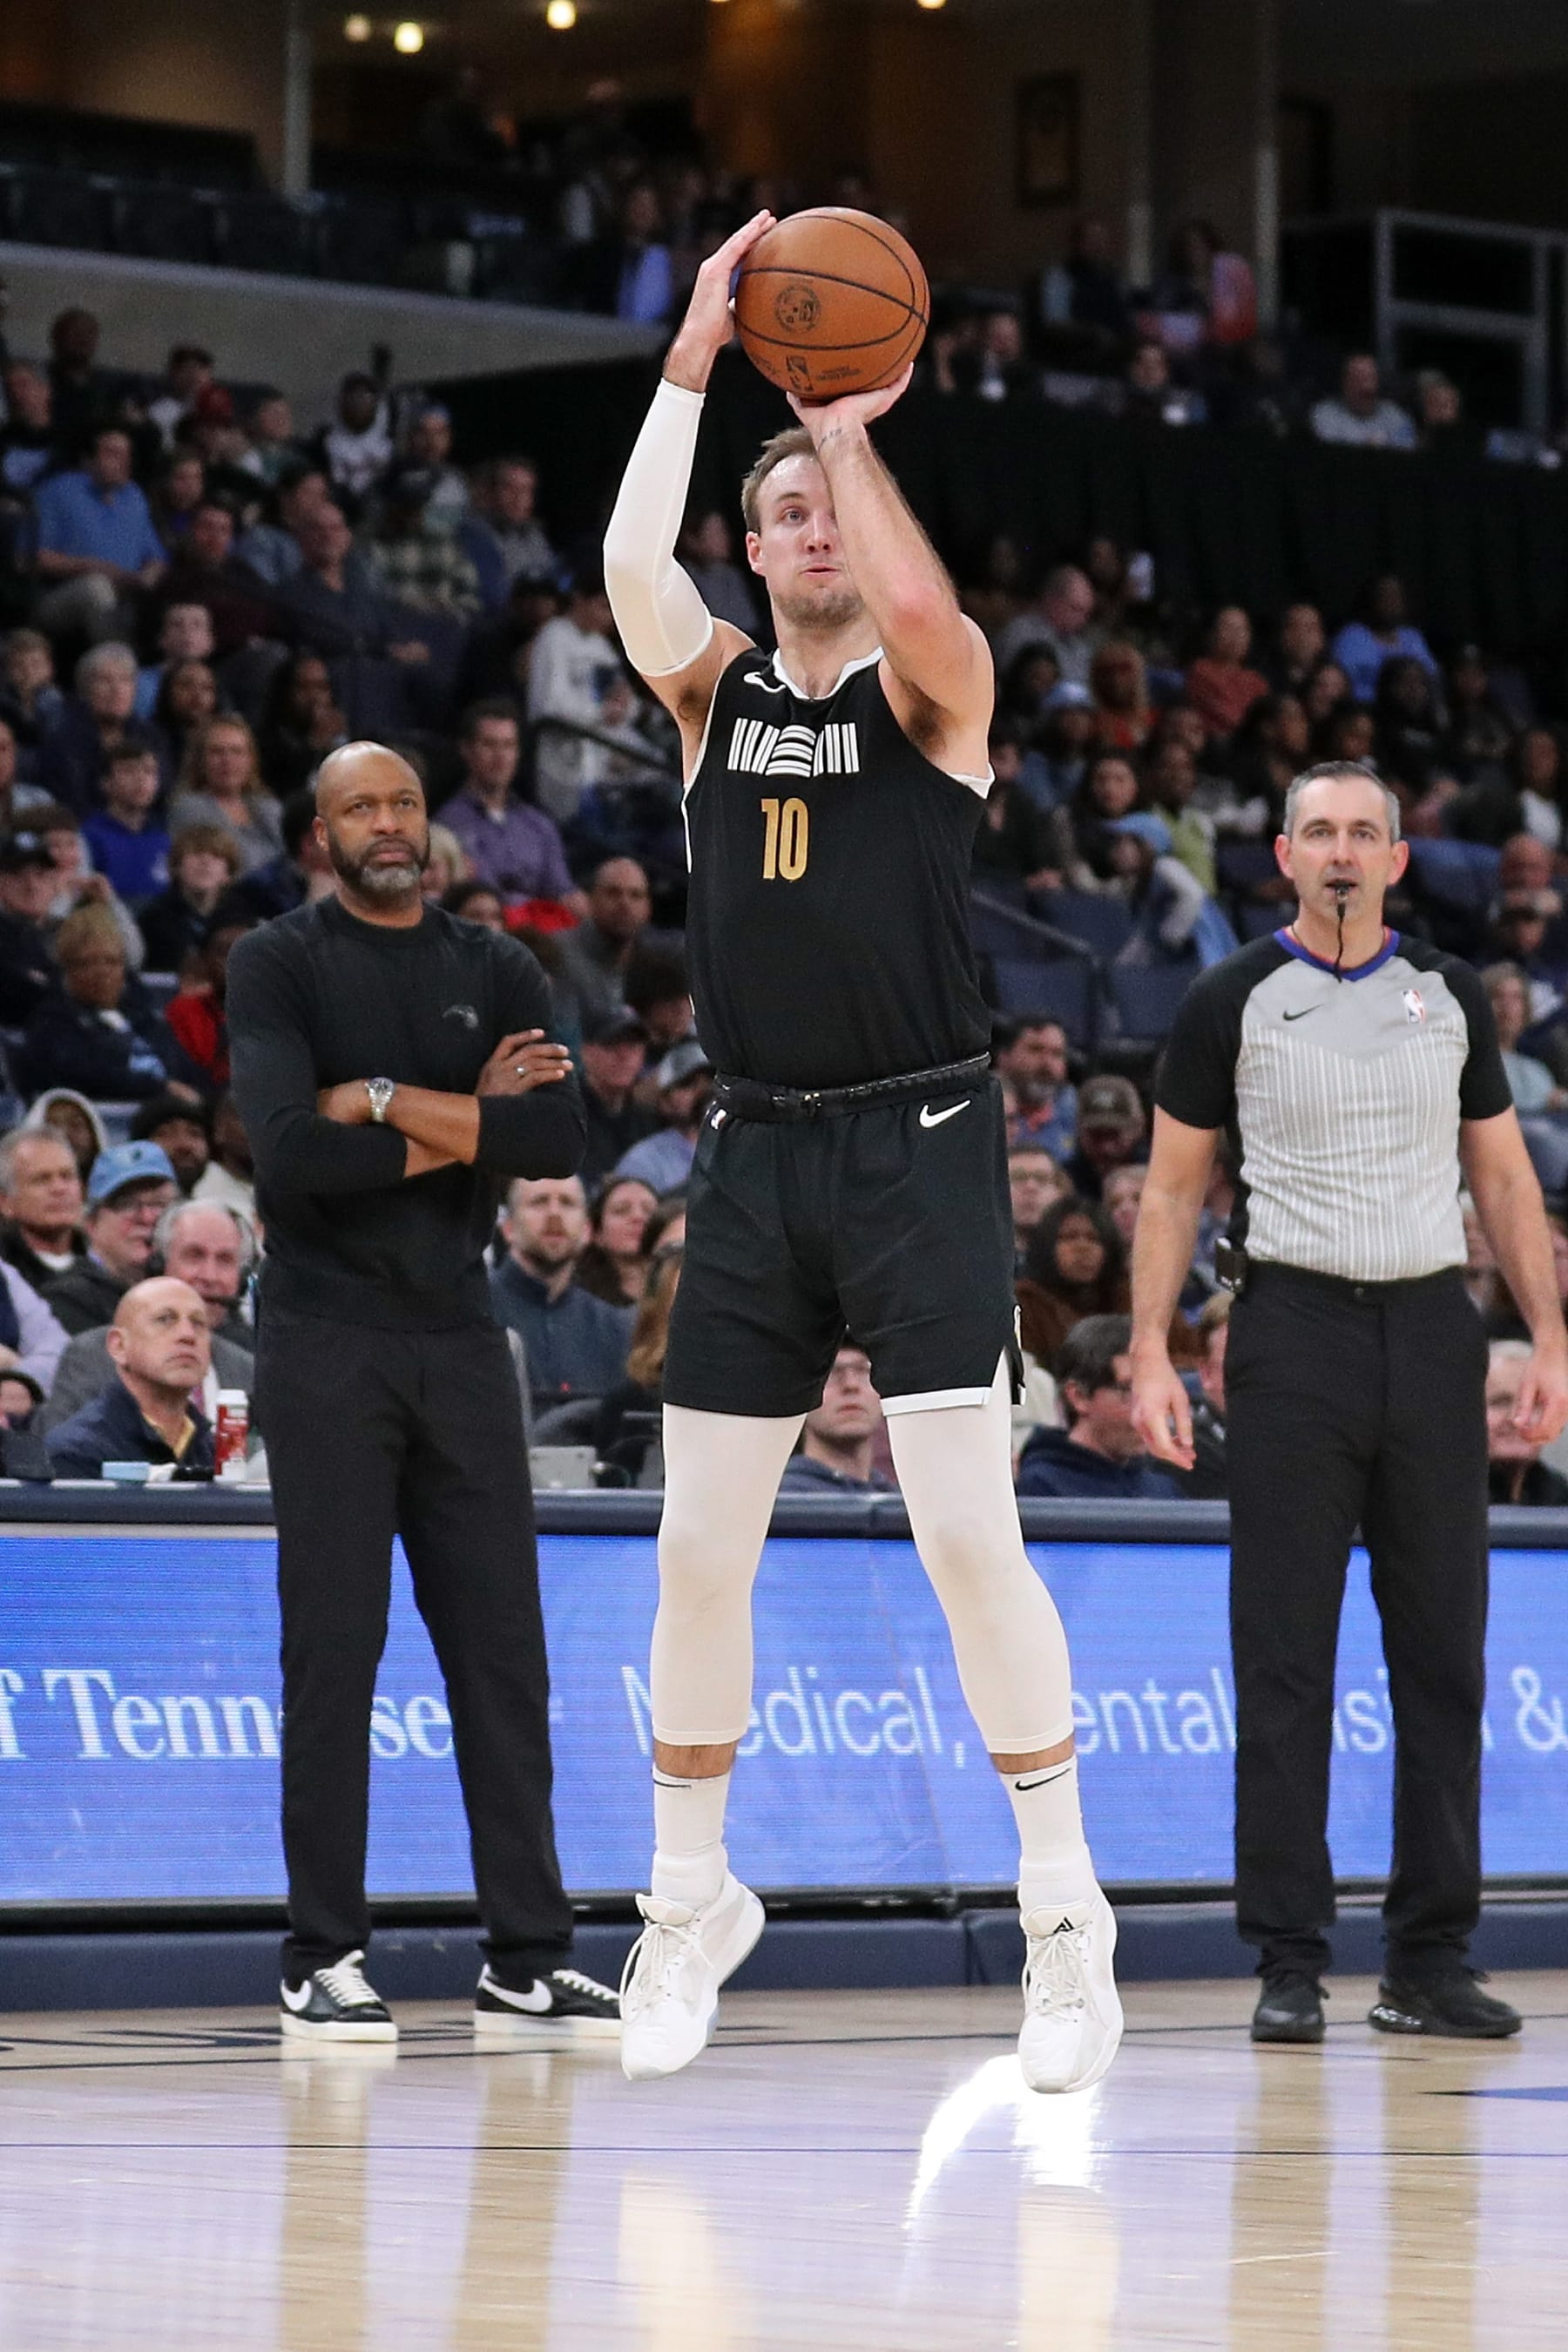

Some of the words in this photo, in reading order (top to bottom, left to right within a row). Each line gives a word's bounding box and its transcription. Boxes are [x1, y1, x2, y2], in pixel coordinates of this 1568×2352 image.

[760, 797, 809, 881] 10
[42, 1667, 454, 1760] Tennse
[1071, 1667, 1237, 1753] ental
